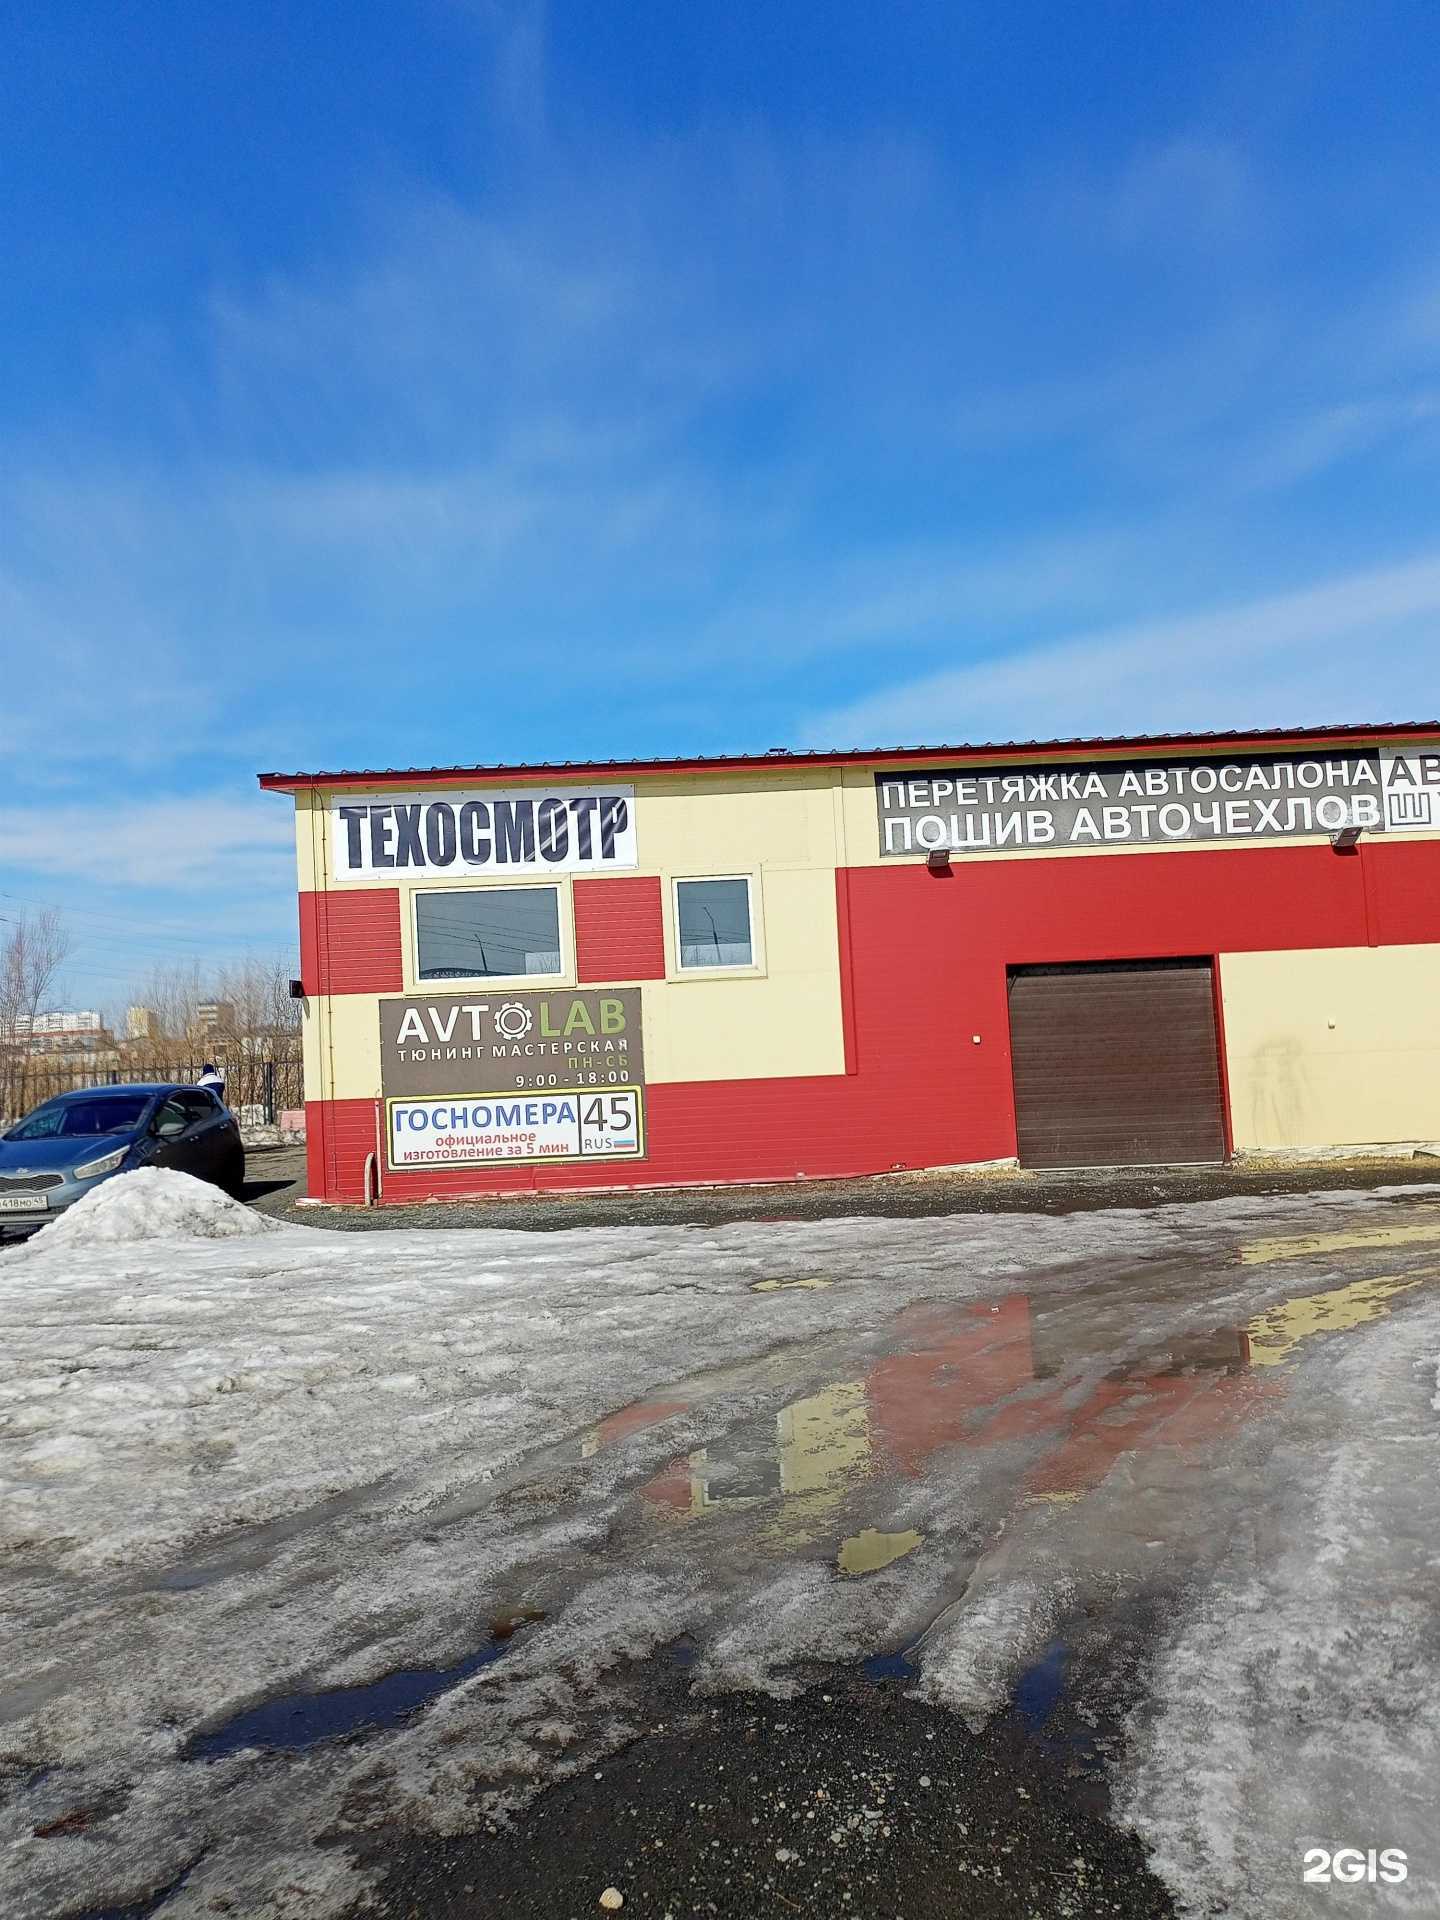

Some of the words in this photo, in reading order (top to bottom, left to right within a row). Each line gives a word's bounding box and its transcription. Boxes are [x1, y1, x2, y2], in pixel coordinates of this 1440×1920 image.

[881, 769, 1108, 809] ПЕРЕТЯЖКА
[1117, 759, 1379, 798] АВТОСАЛОНА
[339, 796, 628, 869] ТЕХОСМОТР
[883, 805, 1056, 851] ПОШИВ
[1068, 794, 1381, 842] АВТОЧЕХЛОВ
[397, 1045, 485, 1062] ТЮНИНГ
[491, 1039, 629, 1058] МАСТЕРСКАЯ
[567, 1055, 629, 1069] ПН-СБ
[515, 1073, 557, 1088] 9:00
[576, 1070, 630, 1085] 18:00
[395, 1101, 576, 1132] ГОСНОМЕРА
[583, 1096, 632, 1132] 45
[435, 1132, 537, 1148] официальное
[583, 1137, 613, 1150] RUS
[403, 1144, 503, 1161] изготовление
[506, 1145, 523, 1156] за
[526, 1143, 534, 1155] 5
[539, 1143, 569, 1154] мин
